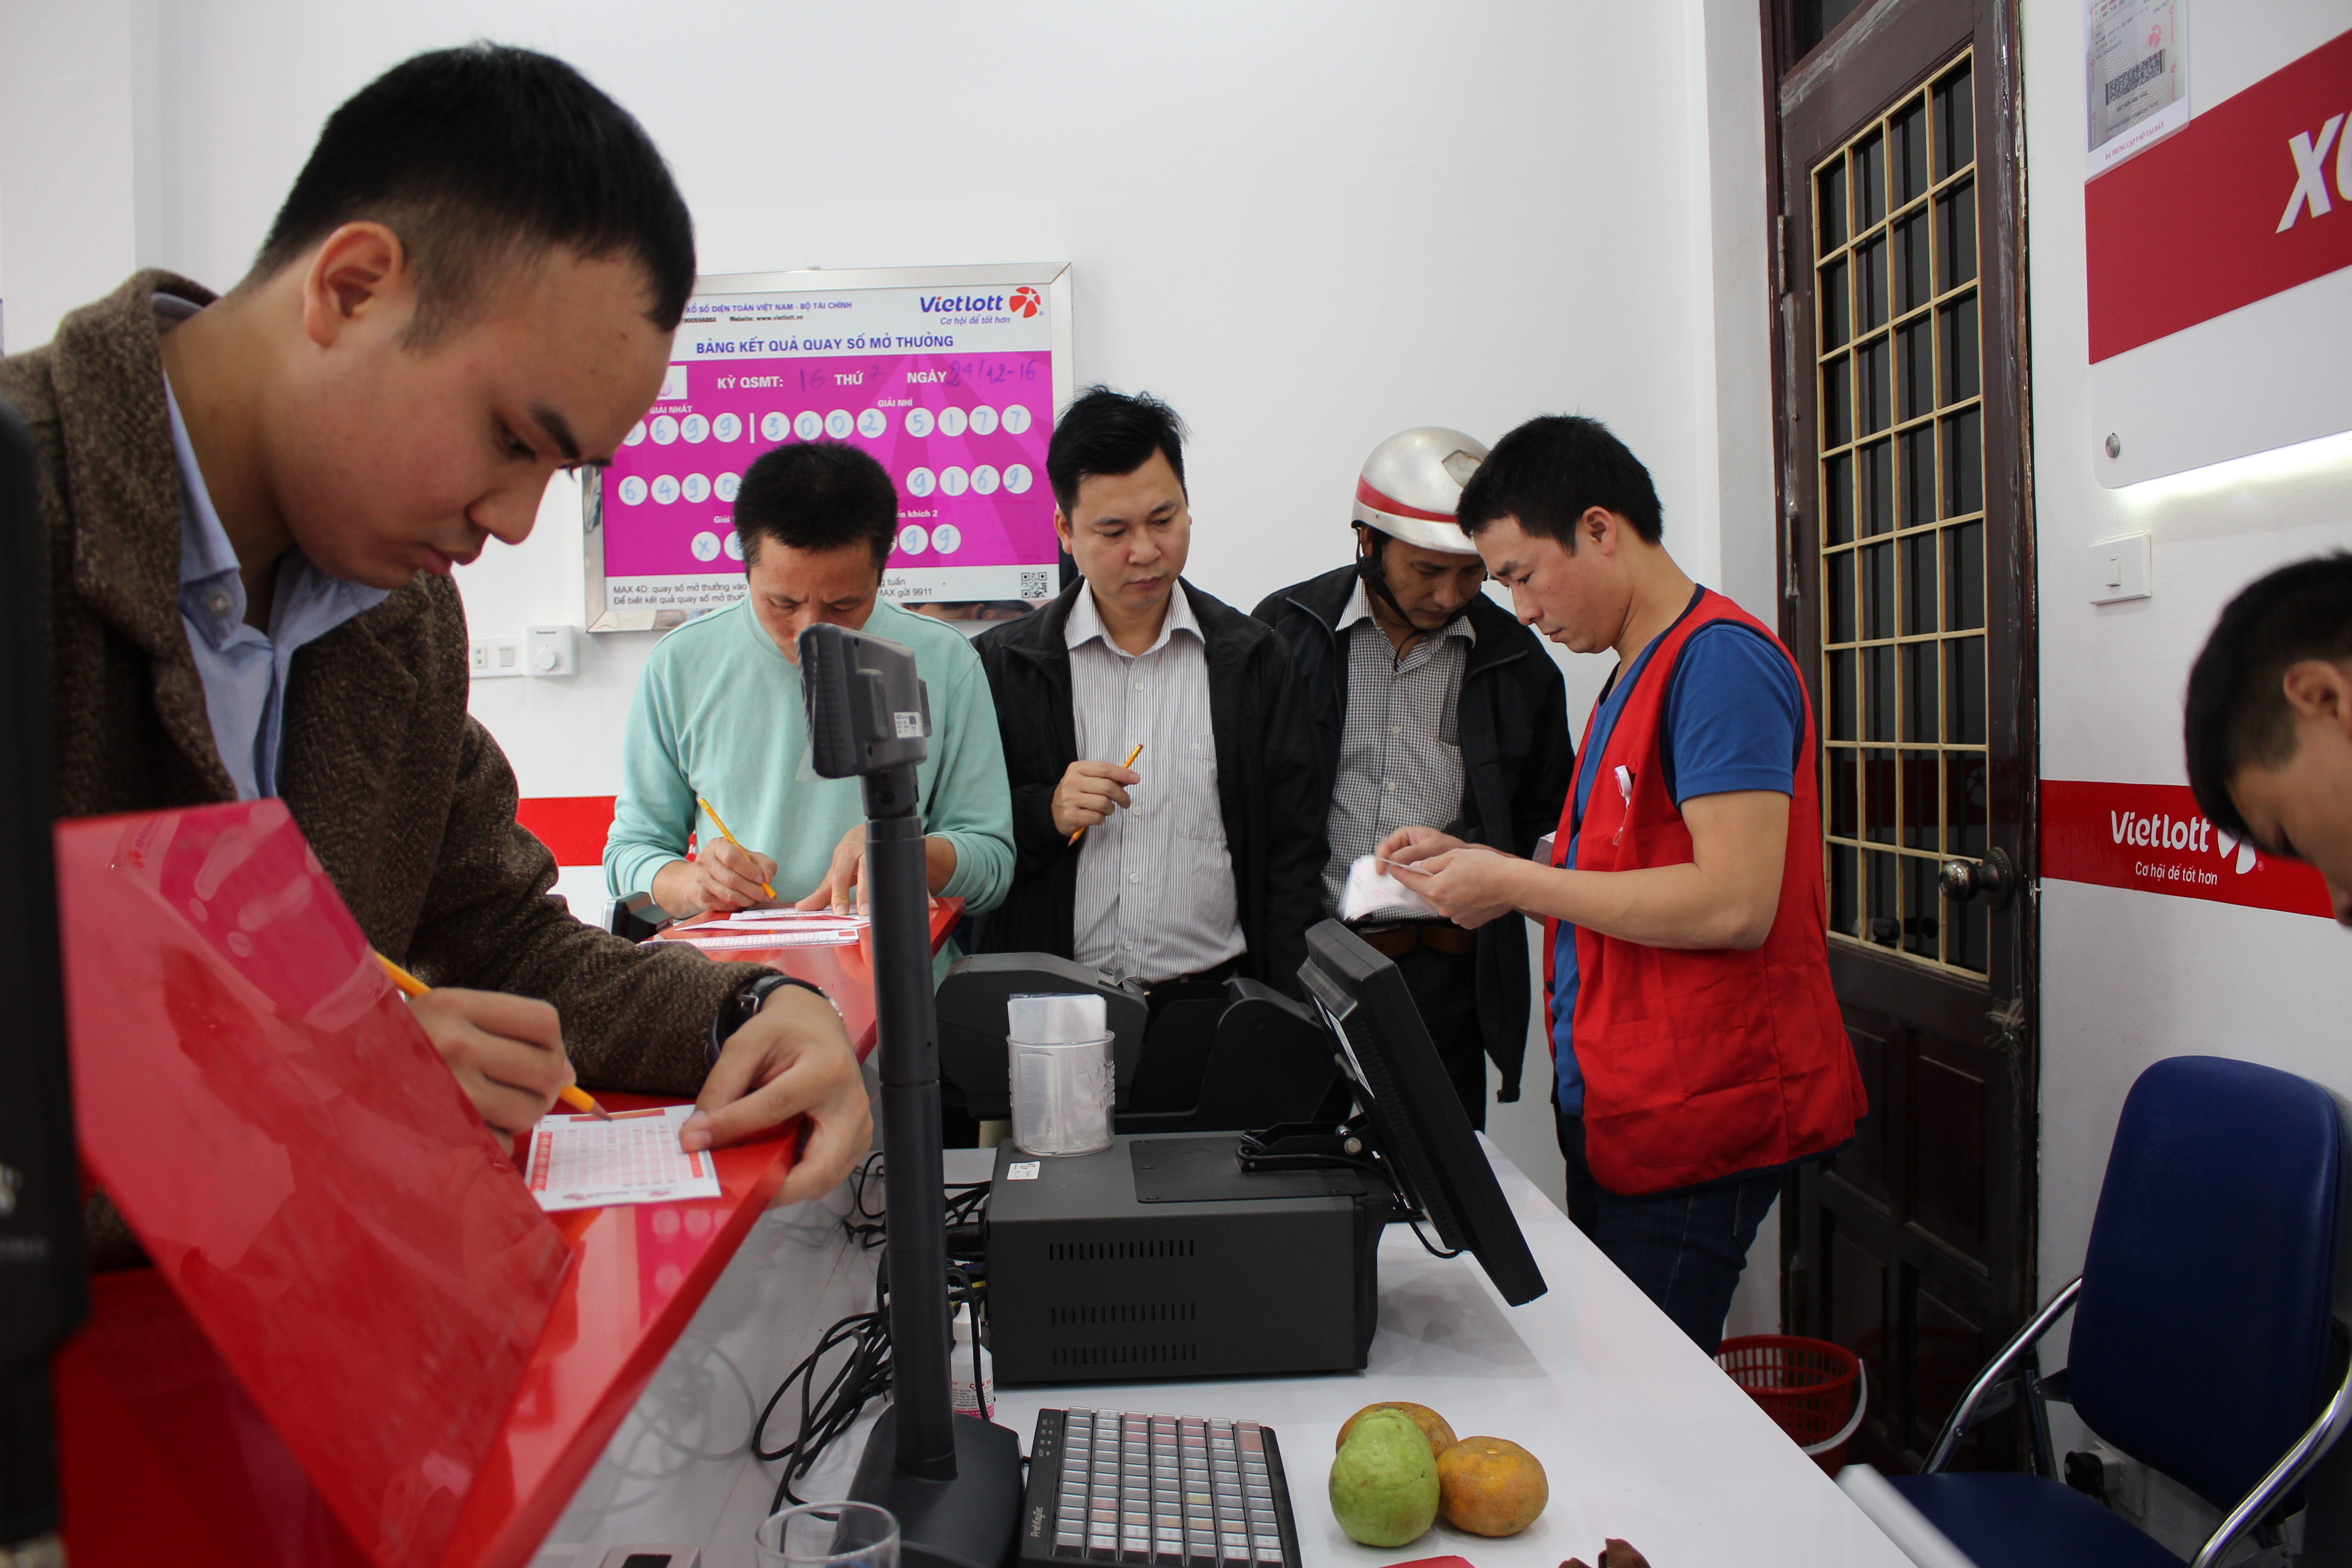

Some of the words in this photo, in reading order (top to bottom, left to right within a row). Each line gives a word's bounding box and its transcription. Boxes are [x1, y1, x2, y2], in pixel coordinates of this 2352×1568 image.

[700, 303, 710, 313] SỐ
[733, 303, 754, 312] TOÁN
[756, 302, 774, 313] VIỆT
[800, 301, 811, 312] BỘ
[828, 300, 852, 309] CHÍNH
[920, 295, 1003, 313] Vietlott
[940, 317, 952, 325] Cơ
[954, 317, 967, 326] hội
[981, 315, 993, 324] tốt
[696, 338, 735, 354] BẢNG
[740, 336, 764, 352] KẾT
[769, 335, 799, 352] QUẢ
[803, 338, 843, 351] QUAY
[847, 333, 865, 349] SỐ
[870, 333, 892, 348] MỞ
[896, 331, 954, 348] THƯỞNG
[834, 371, 864, 385] THỨ
[868, 365, 885, 382] 7
[907, 369, 947, 384] NGÀY
[717, 374, 735, 389] KỲ
[740, 375, 784, 388] QSMT:
[800, 369, 826, 392] 16
[649, 404, 667, 414] GIẢI
[669, 403, 693, 414] NHẤT
[877, 397, 896, 407] GIẢI
[713, 514, 731, 524] Giải
[907, 510, 931, 518] khích
[613, 585, 633, 593] MAX
[652, 586, 672, 594] quay
[675, 583, 686, 592] số
[686, 583, 699, 592] mở
[732, 582, 747, 590] vào
[898, 588, 910, 598] gửi
[913, 588, 932, 596] 9911
[614, 595, 625, 605] Để
[627, 595, 643, 604] biết
[645, 594, 658, 603] kết
[661, 594, 674, 605] quả
[677, 596, 697, 604] quay
[700, 593, 710, 602] số
[712, 592, 725, 602] mở
[2111, 810, 2211, 853] Vietlott
[2135, 861, 2150, 877] Cơ
[2150, 863, 2165, 882] hội
[2168, 862, 2182, 881] để
[2182, 866, 2196, 883] tốt
[2198, 868, 2218, 885] hơn
